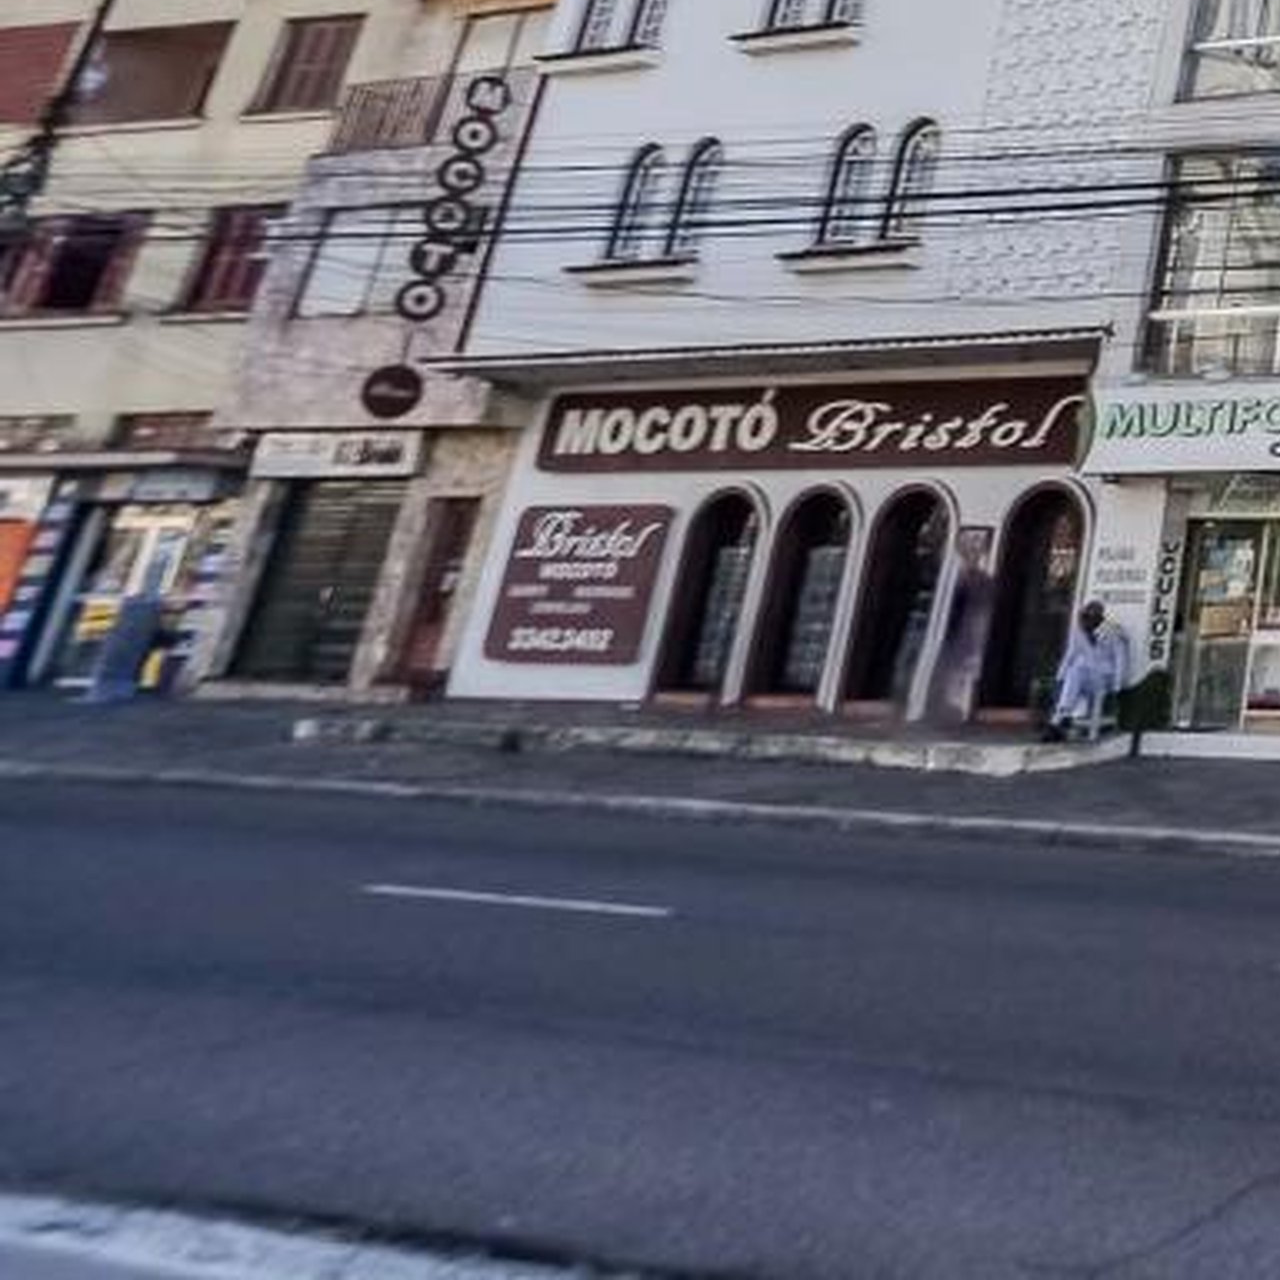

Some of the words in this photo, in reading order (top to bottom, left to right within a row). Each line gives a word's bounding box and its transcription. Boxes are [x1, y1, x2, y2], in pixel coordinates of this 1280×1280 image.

[554, 388, 779, 455] MOCOTÓ
[788, 394, 1087, 451] Bristol
[513, 511, 664, 558] Bristol
